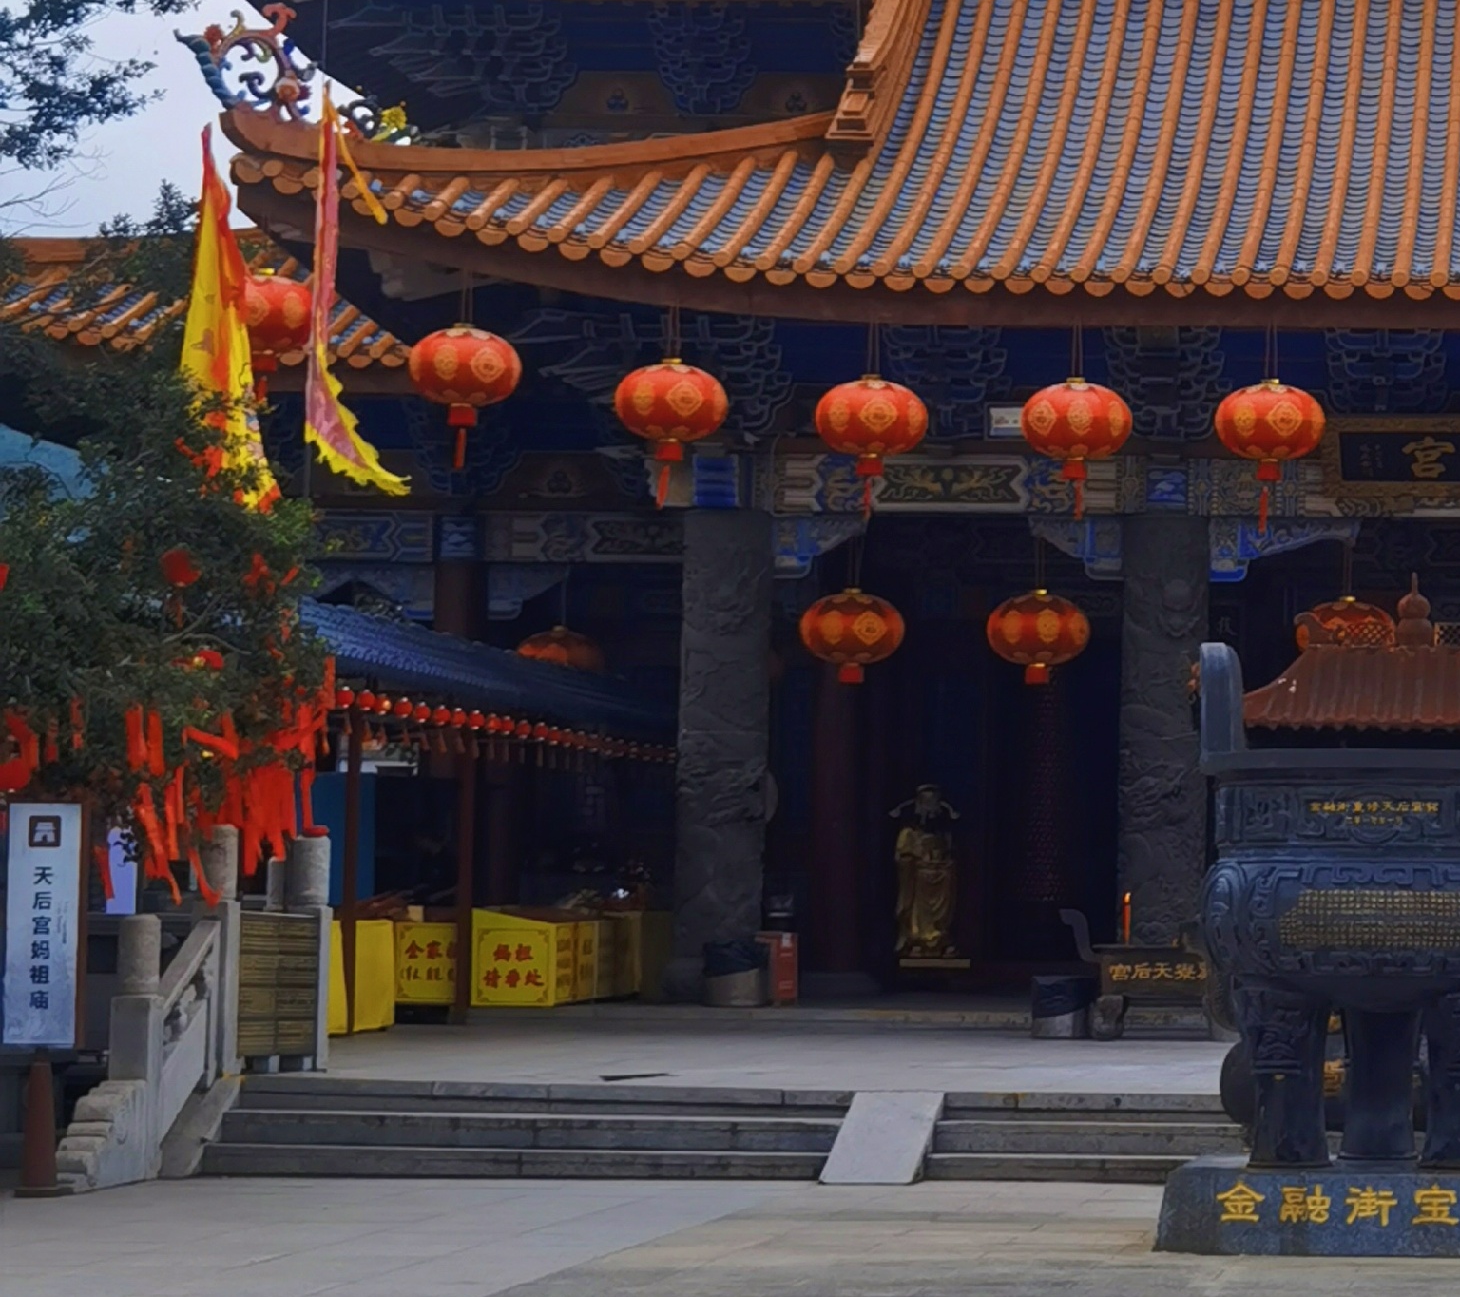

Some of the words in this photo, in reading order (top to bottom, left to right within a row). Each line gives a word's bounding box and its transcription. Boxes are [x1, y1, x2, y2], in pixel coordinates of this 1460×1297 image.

[29, 866, 54, 1011] 天后宫妈祖庙
